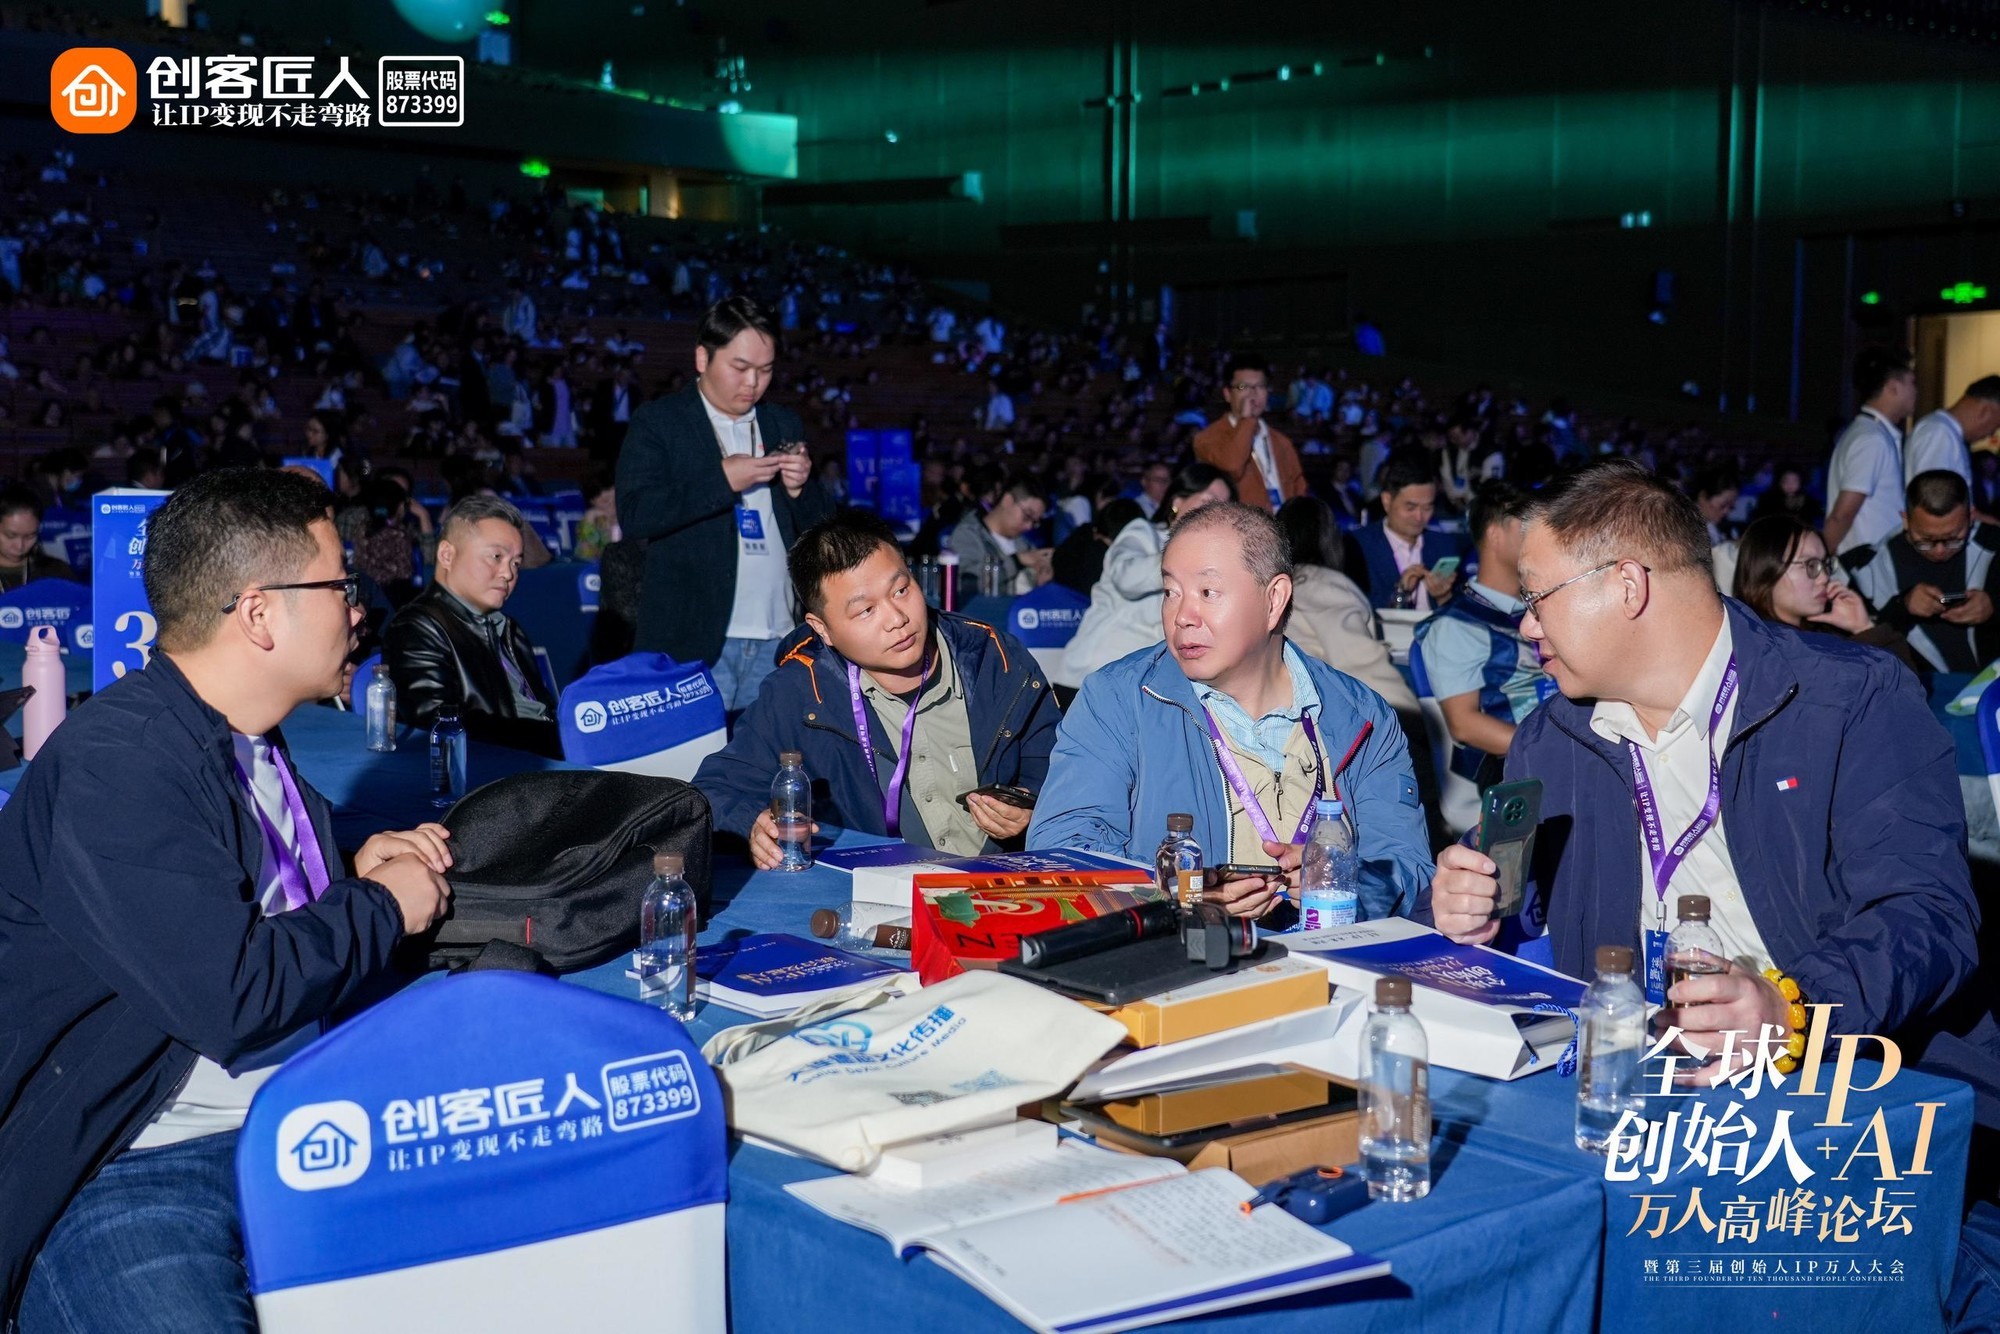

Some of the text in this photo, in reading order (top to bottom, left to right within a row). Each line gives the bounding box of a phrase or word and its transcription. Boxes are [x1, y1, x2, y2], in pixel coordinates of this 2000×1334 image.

[608, 687, 682, 716] 创客匠人
[609, 1062, 688, 1098] 股票代码
[381, 1072, 602, 1145] 创客匠人
[614, 1085, 693, 1121] 873399
[388, 1114, 604, 1173] 让IP变现不走弯路
